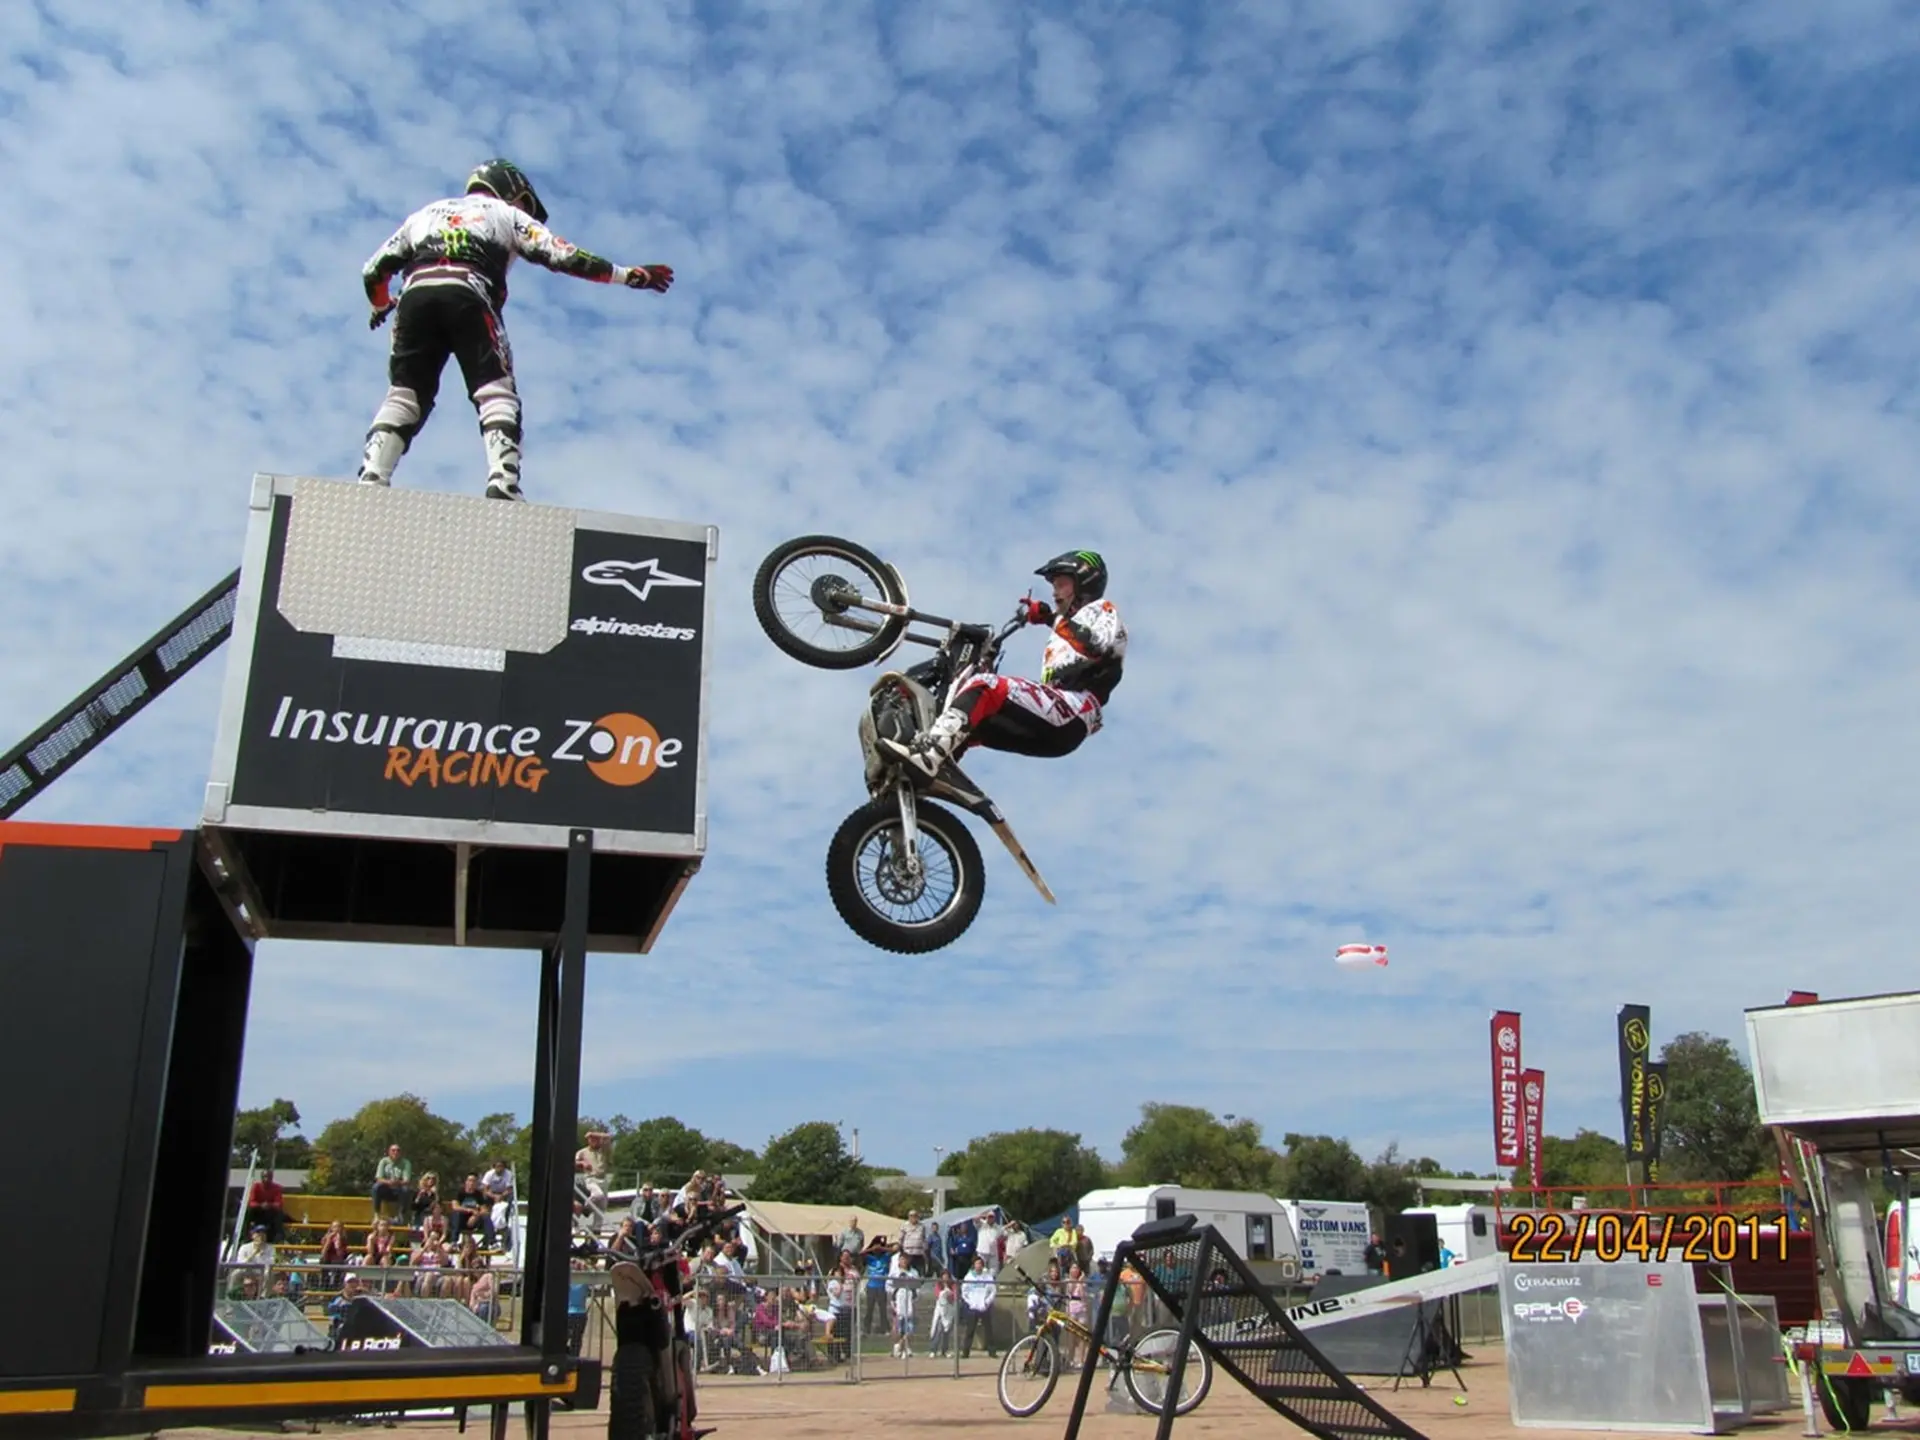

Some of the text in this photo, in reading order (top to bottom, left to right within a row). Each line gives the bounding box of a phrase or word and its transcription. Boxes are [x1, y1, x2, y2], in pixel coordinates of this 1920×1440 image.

[569, 616, 697, 641] alpinestars
[269, 695, 683, 769] Insurance Zone
[383, 745, 550, 793] RACING
[1501, 1055, 1518, 1159] ELEMENT
[1300, 1219, 1367, 1233] CUSTOM VANS
